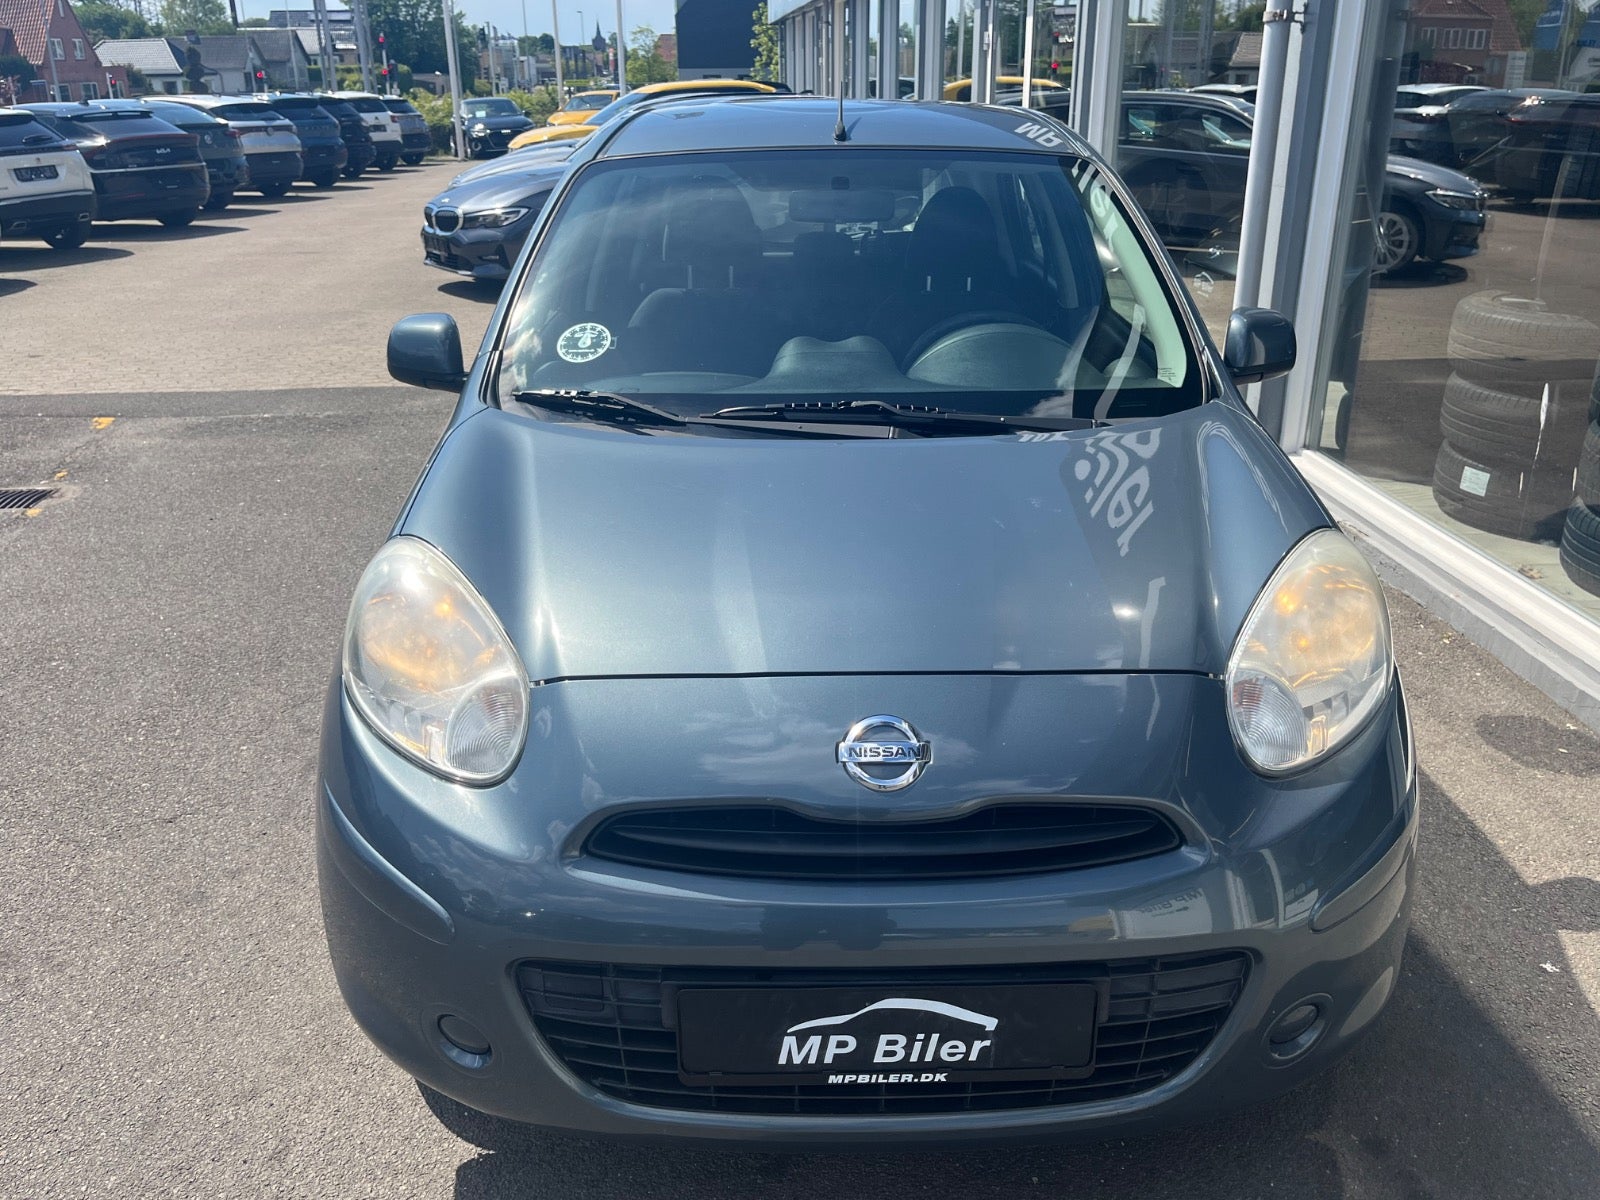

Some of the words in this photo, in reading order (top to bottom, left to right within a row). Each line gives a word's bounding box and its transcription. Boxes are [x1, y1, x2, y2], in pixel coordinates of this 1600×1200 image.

[848, 747, 921, 758] NISSAN
[778, 1035, 857, 1065] MP
[873, 1033, 992, 1063] Biler
[828, 1072, 948, 1084] MPBILER.DK
